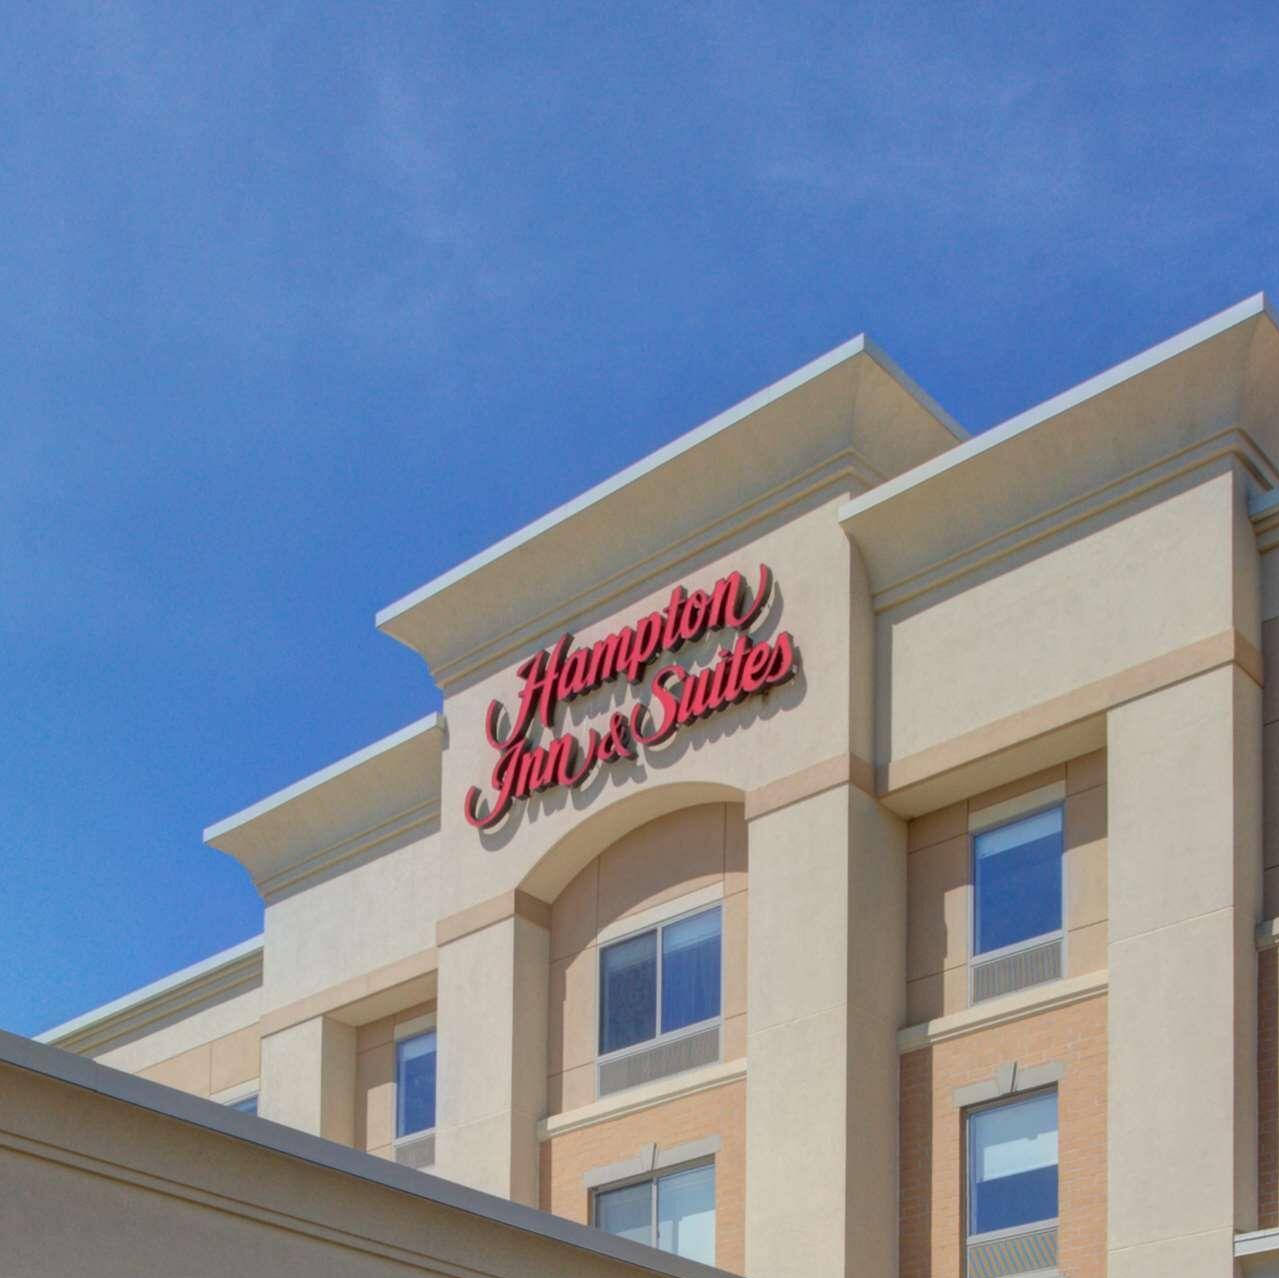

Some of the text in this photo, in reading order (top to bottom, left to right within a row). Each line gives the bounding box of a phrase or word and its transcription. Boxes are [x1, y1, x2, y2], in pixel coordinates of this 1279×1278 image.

[464, 631, 796, 828] Inn & Suites
[486, 563, 773, 750] Hampton
